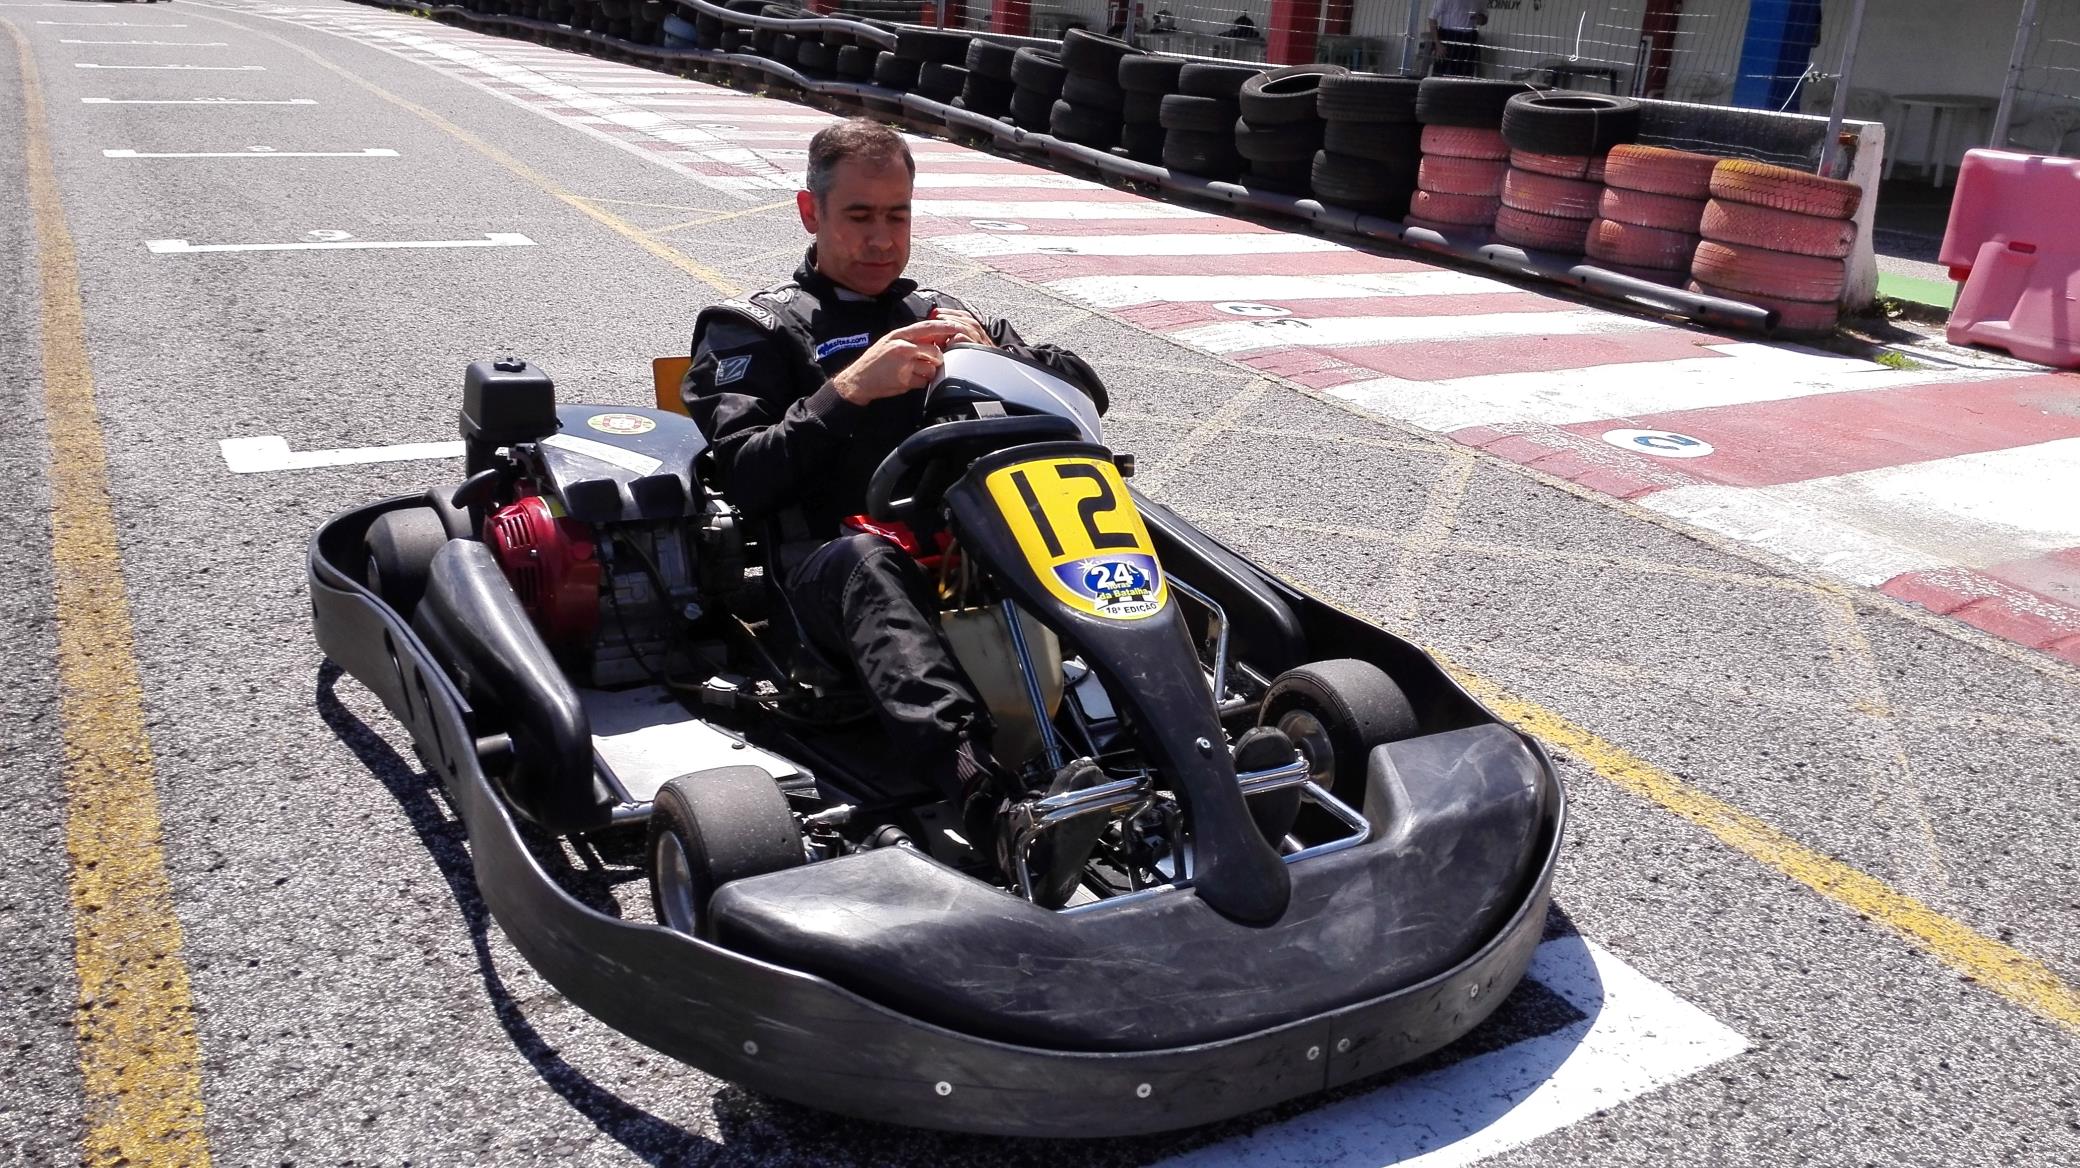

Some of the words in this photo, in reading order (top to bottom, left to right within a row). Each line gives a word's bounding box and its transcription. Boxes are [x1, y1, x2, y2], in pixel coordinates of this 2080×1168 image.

[1010, 463, 1140, 558] 12
[1113, 588, 1150, 597] Batalha
[1123, 602, 1157, 614] EDIÇÃO
